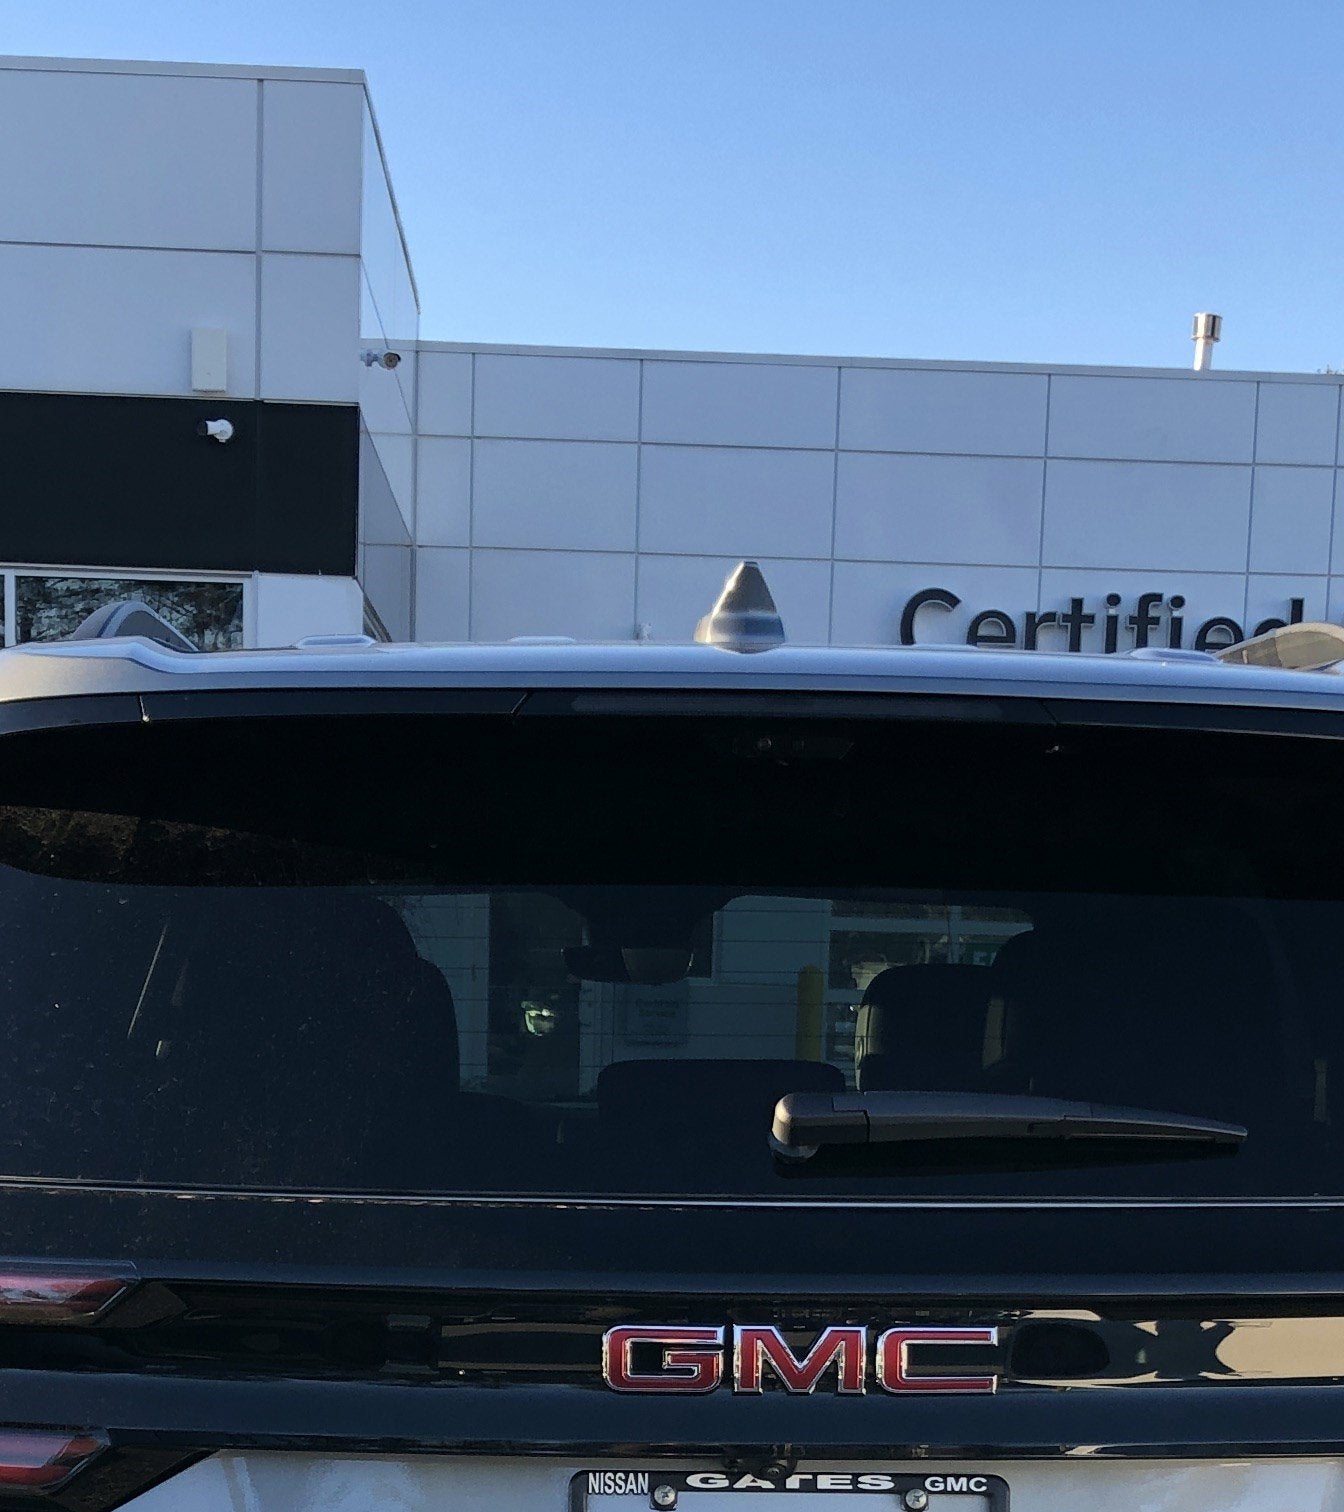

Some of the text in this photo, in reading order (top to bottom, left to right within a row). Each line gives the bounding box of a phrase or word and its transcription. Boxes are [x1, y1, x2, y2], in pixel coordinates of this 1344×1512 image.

[601, 1323, 998, 1395] GMC
[587, 1473, 988, 1496] NISSAN GATES GMC
